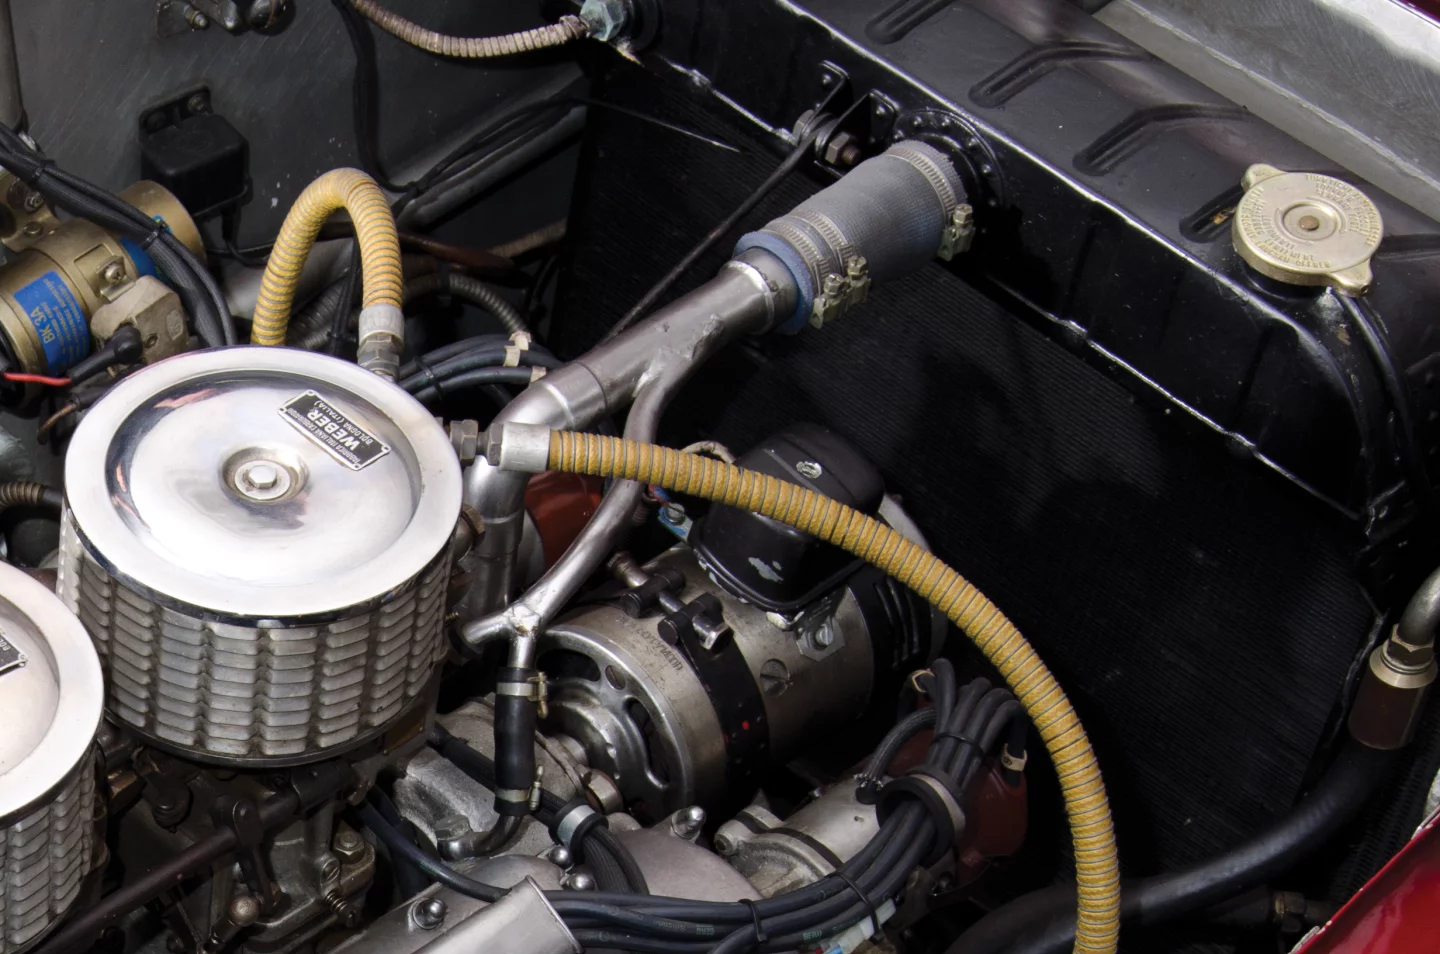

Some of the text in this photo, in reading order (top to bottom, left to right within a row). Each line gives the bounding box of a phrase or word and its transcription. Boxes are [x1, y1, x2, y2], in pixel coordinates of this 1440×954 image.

[29, 306, 55, 344] BK 3A
[306, 408, 361, 451] WEBER
[314, 399, 374, 446] BOLOGNA (ITALIA)
[802, 929, 823, 941] BERU
